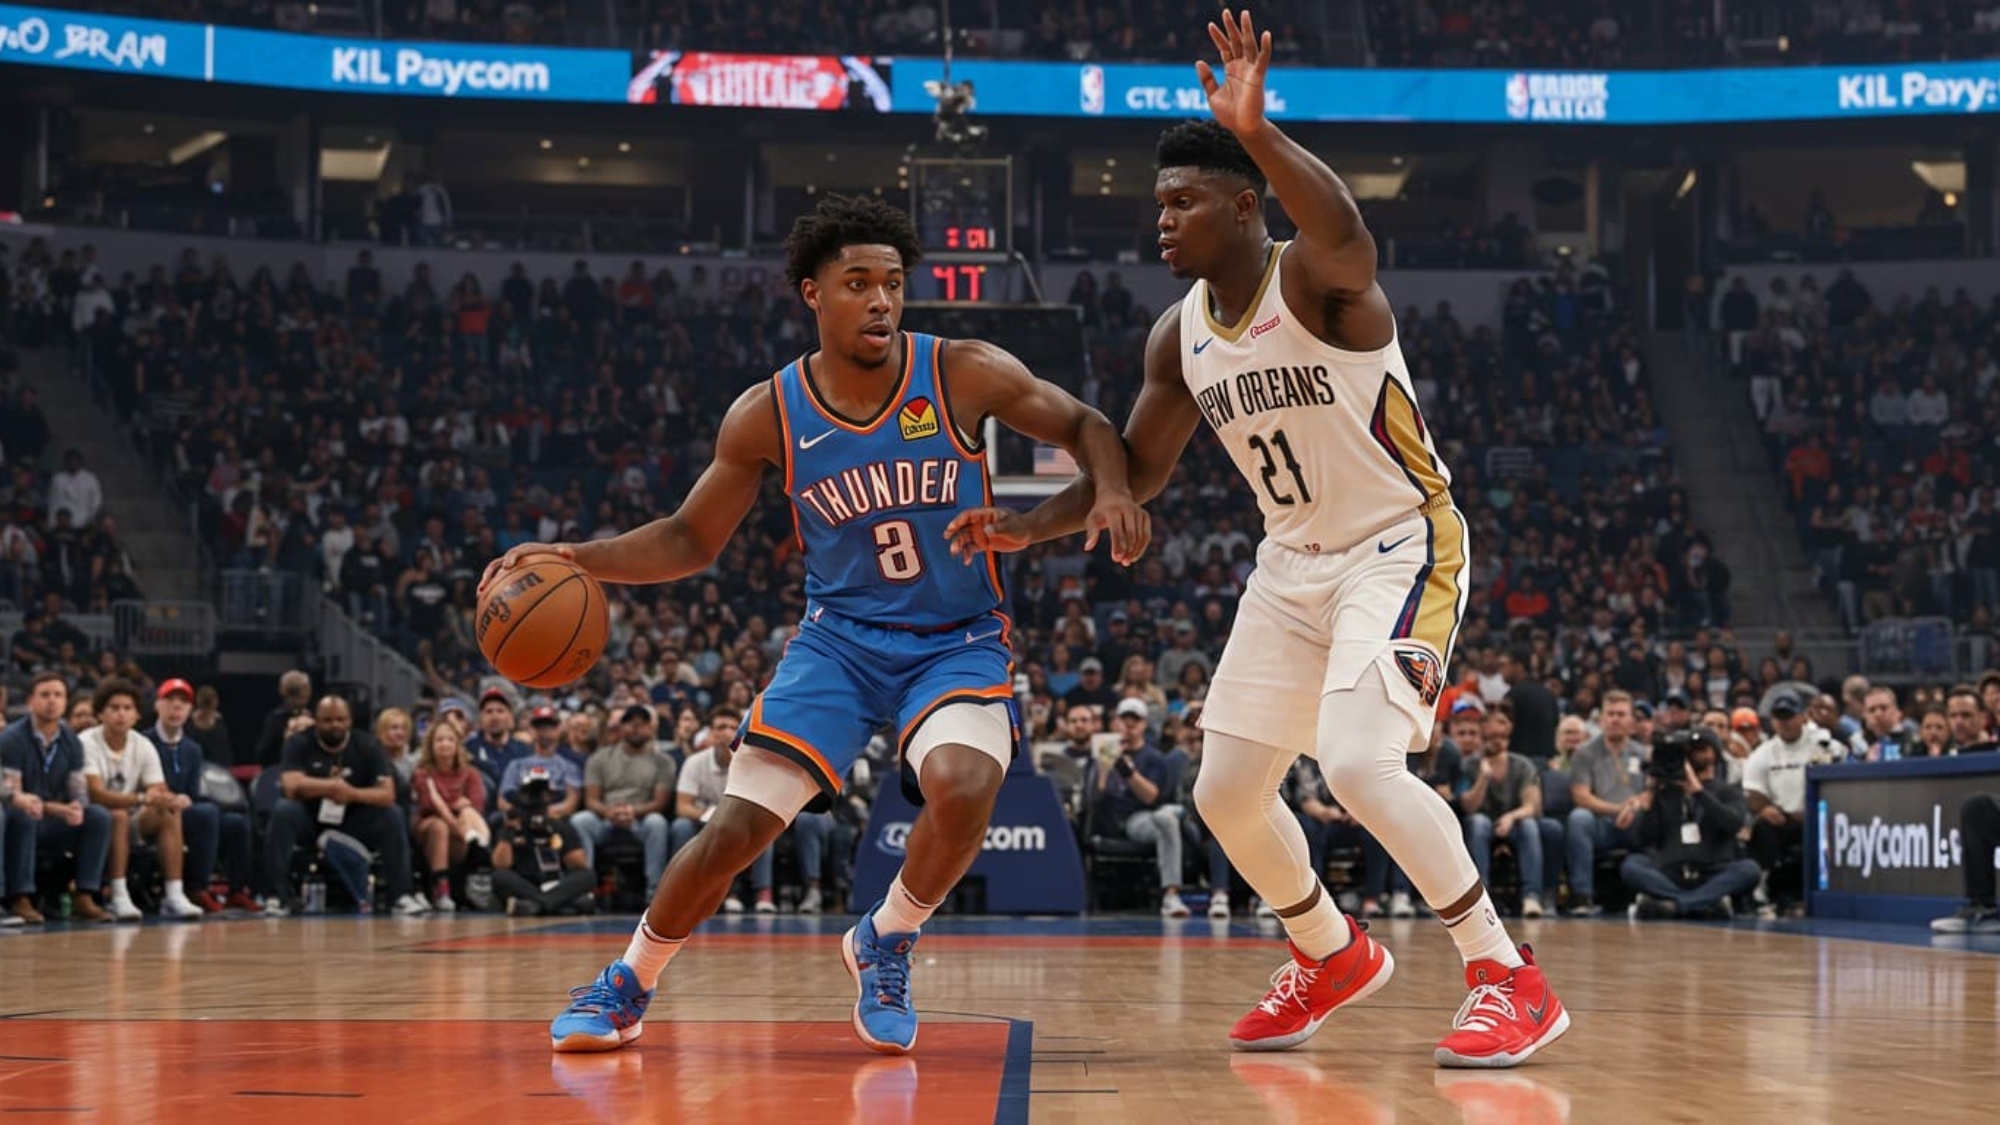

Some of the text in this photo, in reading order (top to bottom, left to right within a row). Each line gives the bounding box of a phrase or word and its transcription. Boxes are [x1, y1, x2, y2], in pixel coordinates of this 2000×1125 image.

[332, 47, 549, 96] KIL Paycom
[801, 460, 960, 527] THUNDER
[1248, 429, 1312, 505] 21
